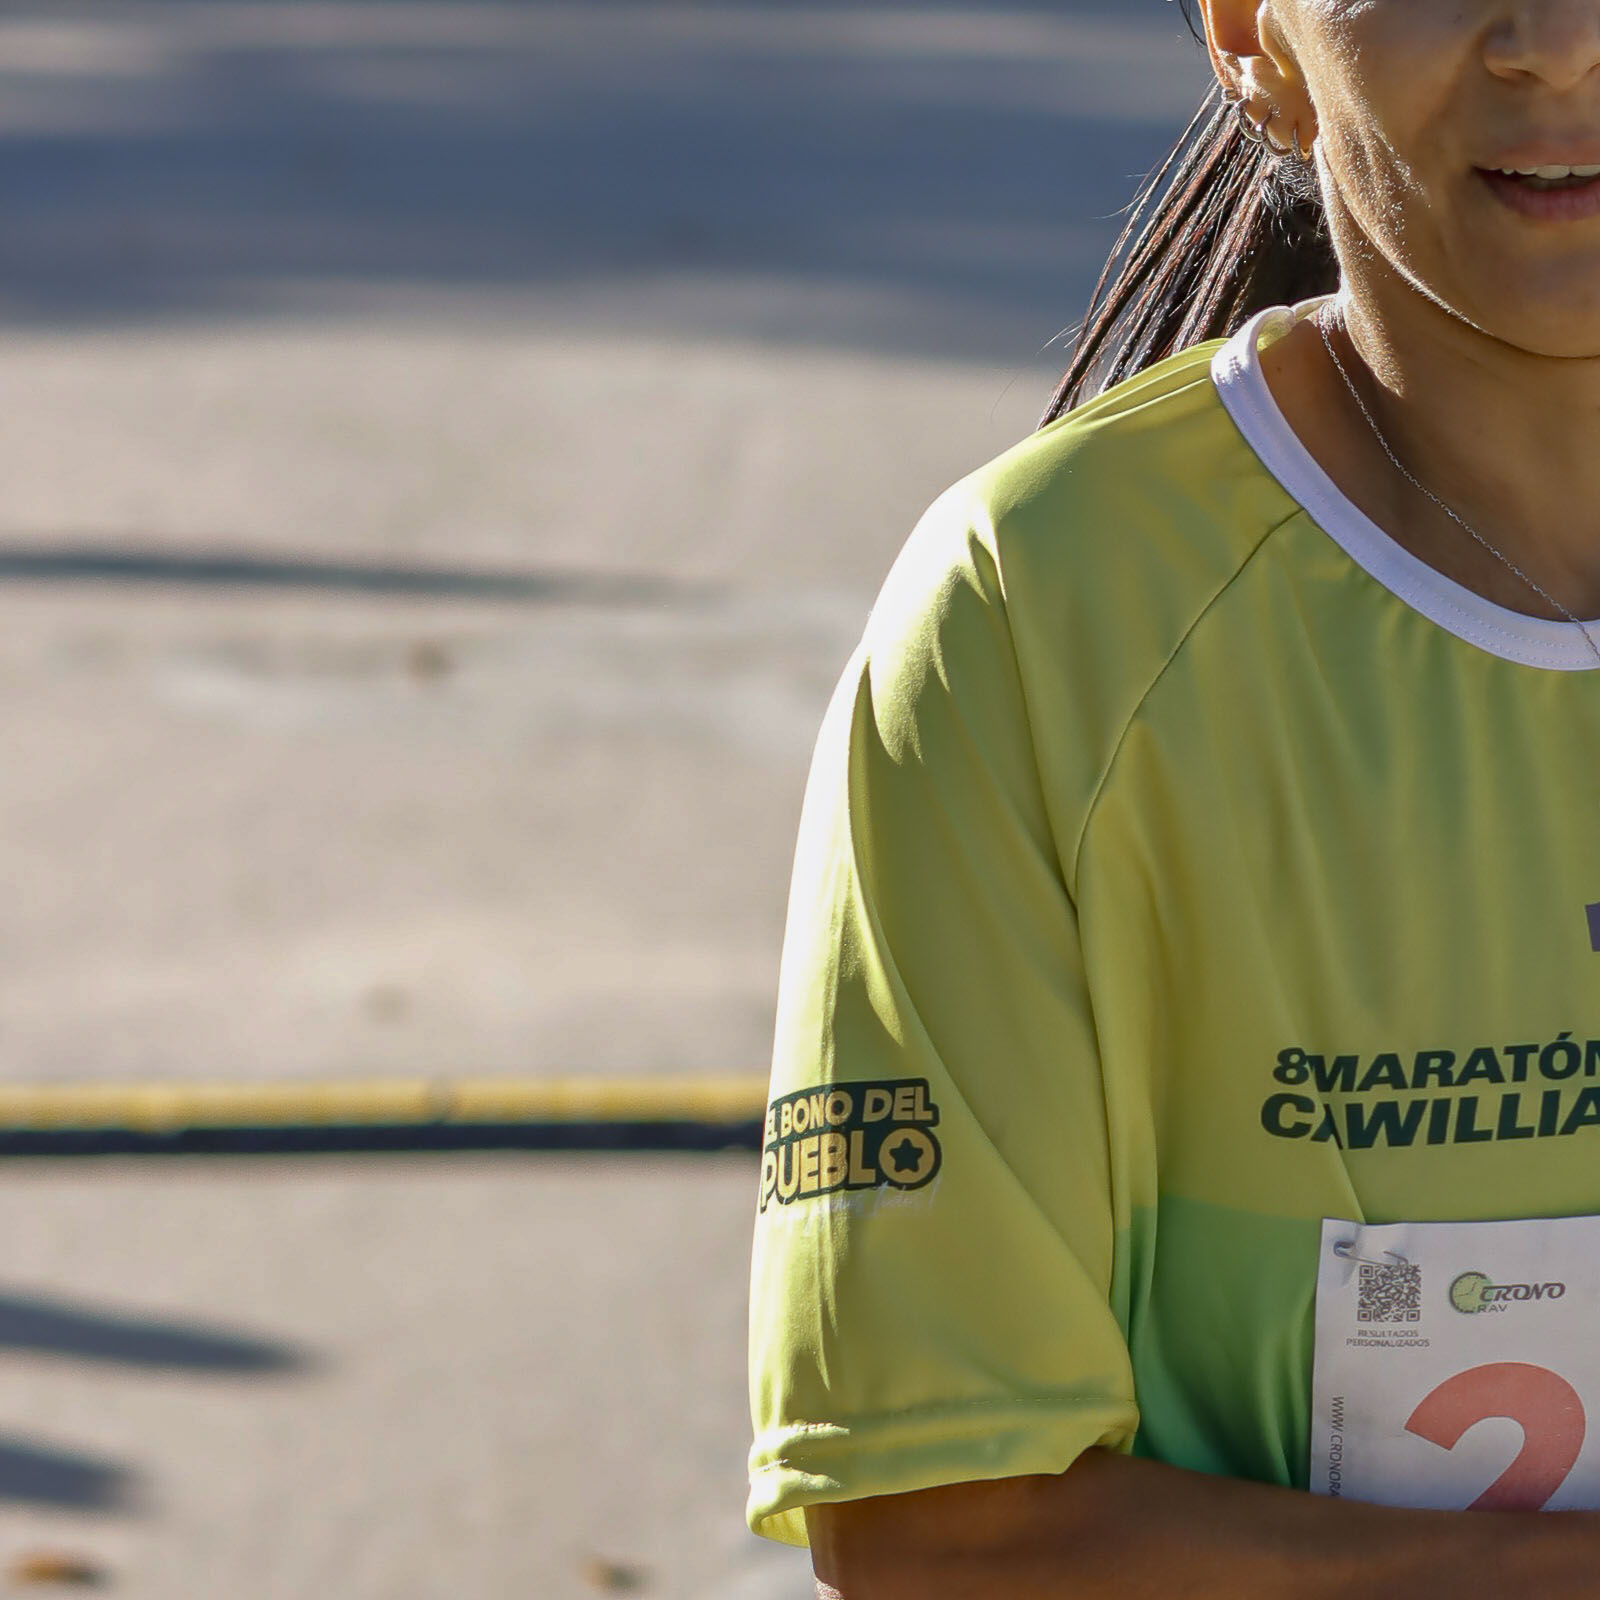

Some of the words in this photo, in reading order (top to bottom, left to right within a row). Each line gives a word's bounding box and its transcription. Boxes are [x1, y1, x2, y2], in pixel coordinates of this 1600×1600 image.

[780, 1090, 853, 1138] BONO
[863, 1086, 934, 1123] DEL
[761, 1127, 935, 1208] PUEBLO
[1477, 1303, 1508, 1314] RAV
[1357, 1329, 1420, 1338] RESULTADOS
[1346, 1337, 1431, 1348] PERSONALIZADOS
